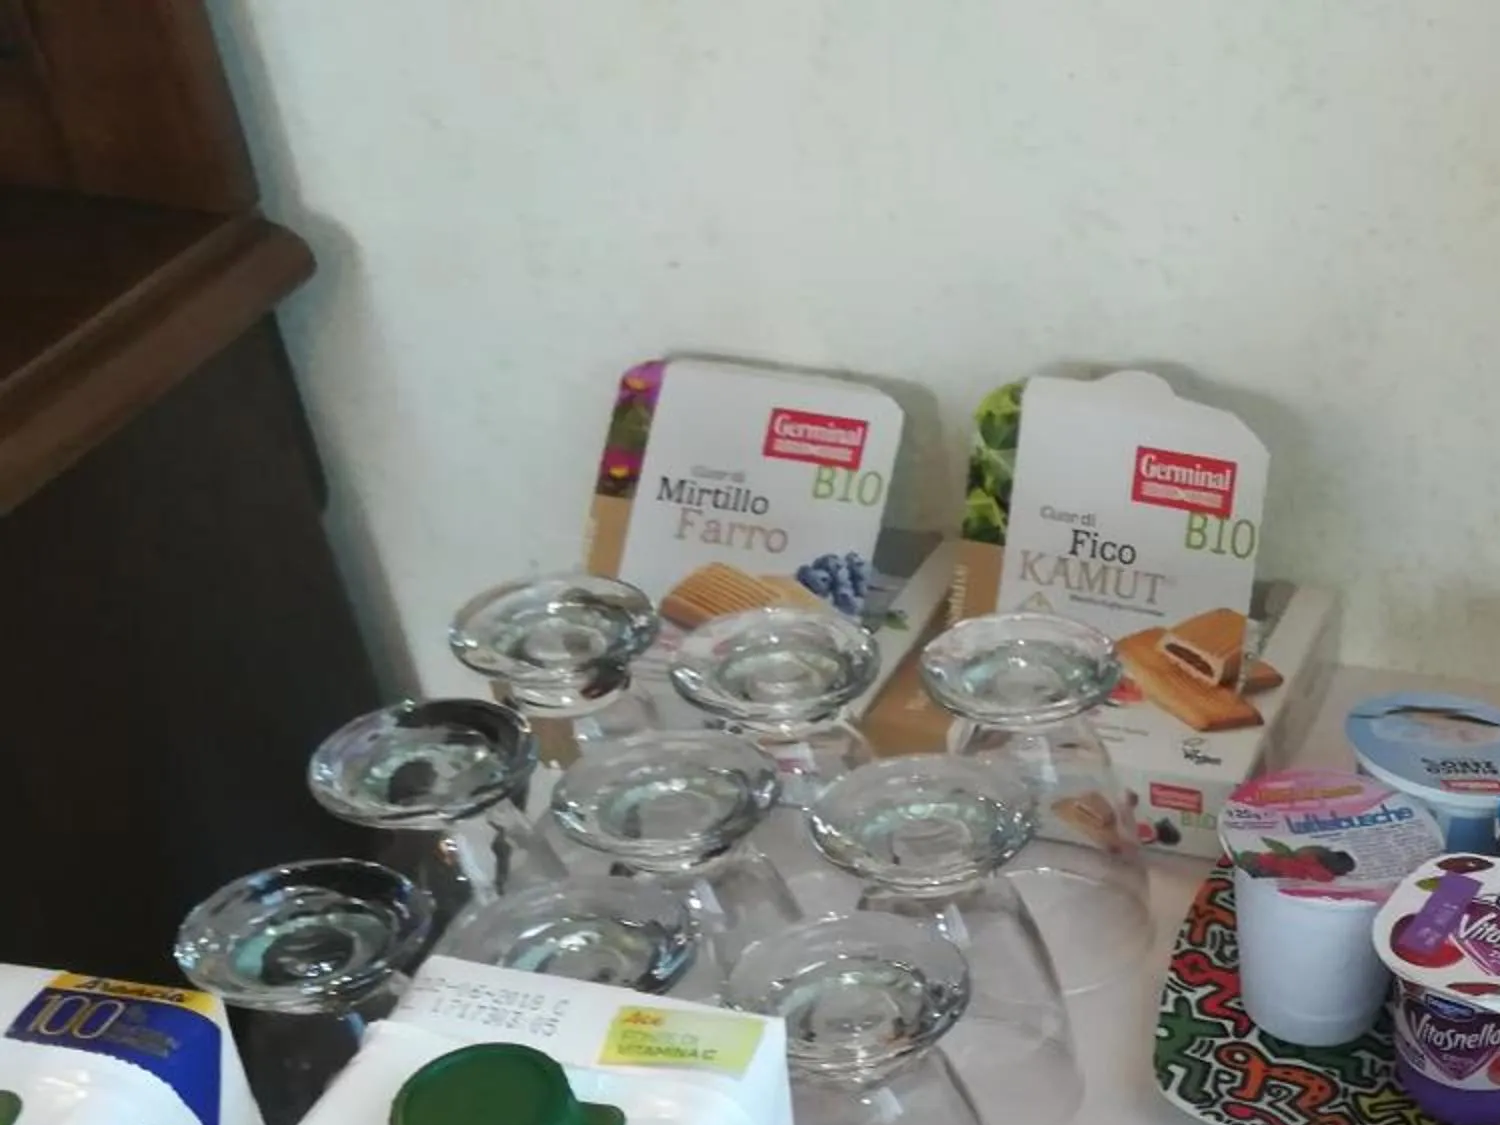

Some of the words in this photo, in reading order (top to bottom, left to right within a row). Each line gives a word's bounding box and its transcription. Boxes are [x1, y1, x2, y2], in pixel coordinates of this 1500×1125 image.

[773, 413, 863, 446] Germinal
[811, 465, 884, 507] BIO
[1140, 453, 1232, 491] Germinal
[656, 475, 770, 515] Mirtillo
[672, 507, 789, 554] Farro
[1068, 528, 1137, 566] Fico
[1185, 511, 1257, 560] BIO
[1019, 550, 1166, 605] KAMUT
